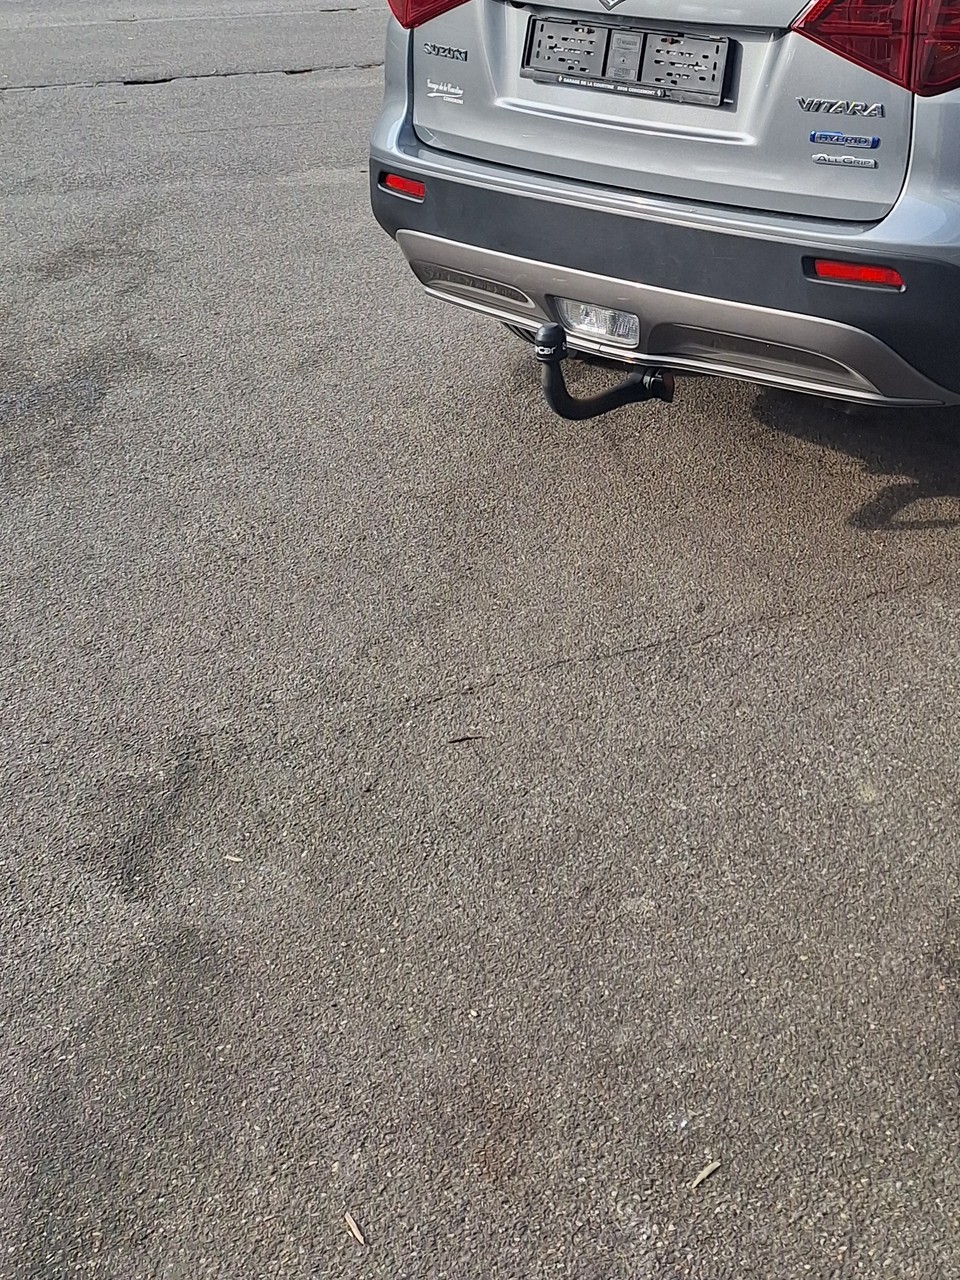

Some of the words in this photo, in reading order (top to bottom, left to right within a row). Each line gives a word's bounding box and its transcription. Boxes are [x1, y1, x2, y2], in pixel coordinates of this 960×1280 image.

[423, 42, 467, 61] SUZUKI
[795, 96, 886, 118] VITARA
[818, 133, 868, 144] HYBRID
